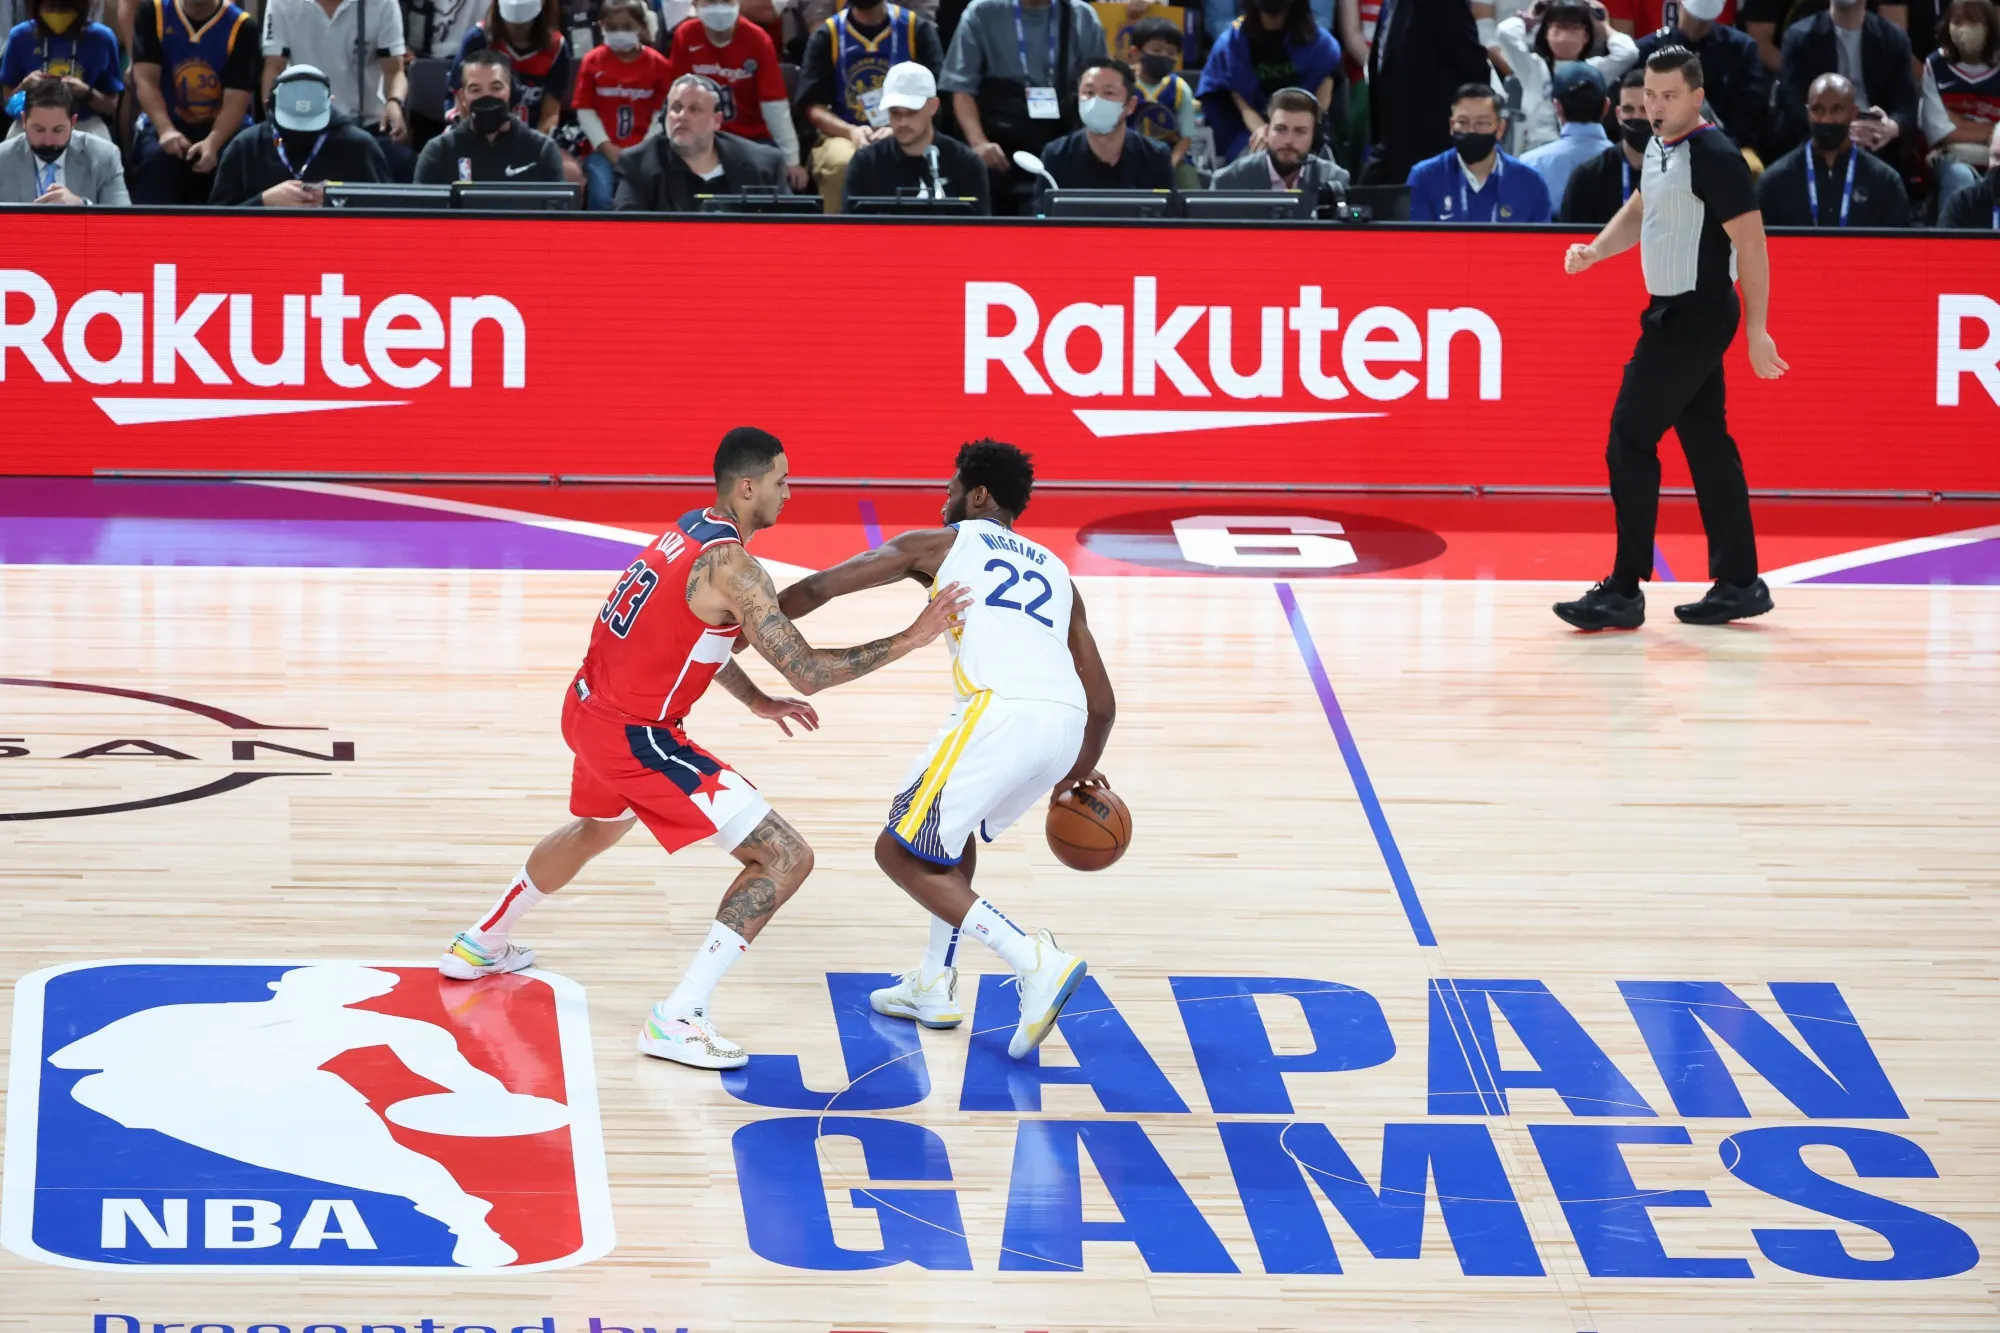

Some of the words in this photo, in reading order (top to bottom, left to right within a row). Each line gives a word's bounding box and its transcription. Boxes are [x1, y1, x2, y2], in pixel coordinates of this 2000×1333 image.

[196, 73, 219, 90] 30
[616, 104, 635, 140] 8
[0, 263, 526, 389] Rakuten
[964, 276, 1503, 401] Rakuten
[979, 532, 1048, 566] WIGGINS
[1170, 514, 1358, 568] 6
[599, 558, 659, 640] 33
[983, 558, 1054, 628] 22
[721, 972, 1908, 1120] JAPAN
[100, 1198, 379, 1251] NBA
[732, 1117, 1980, 1281] GAMES
